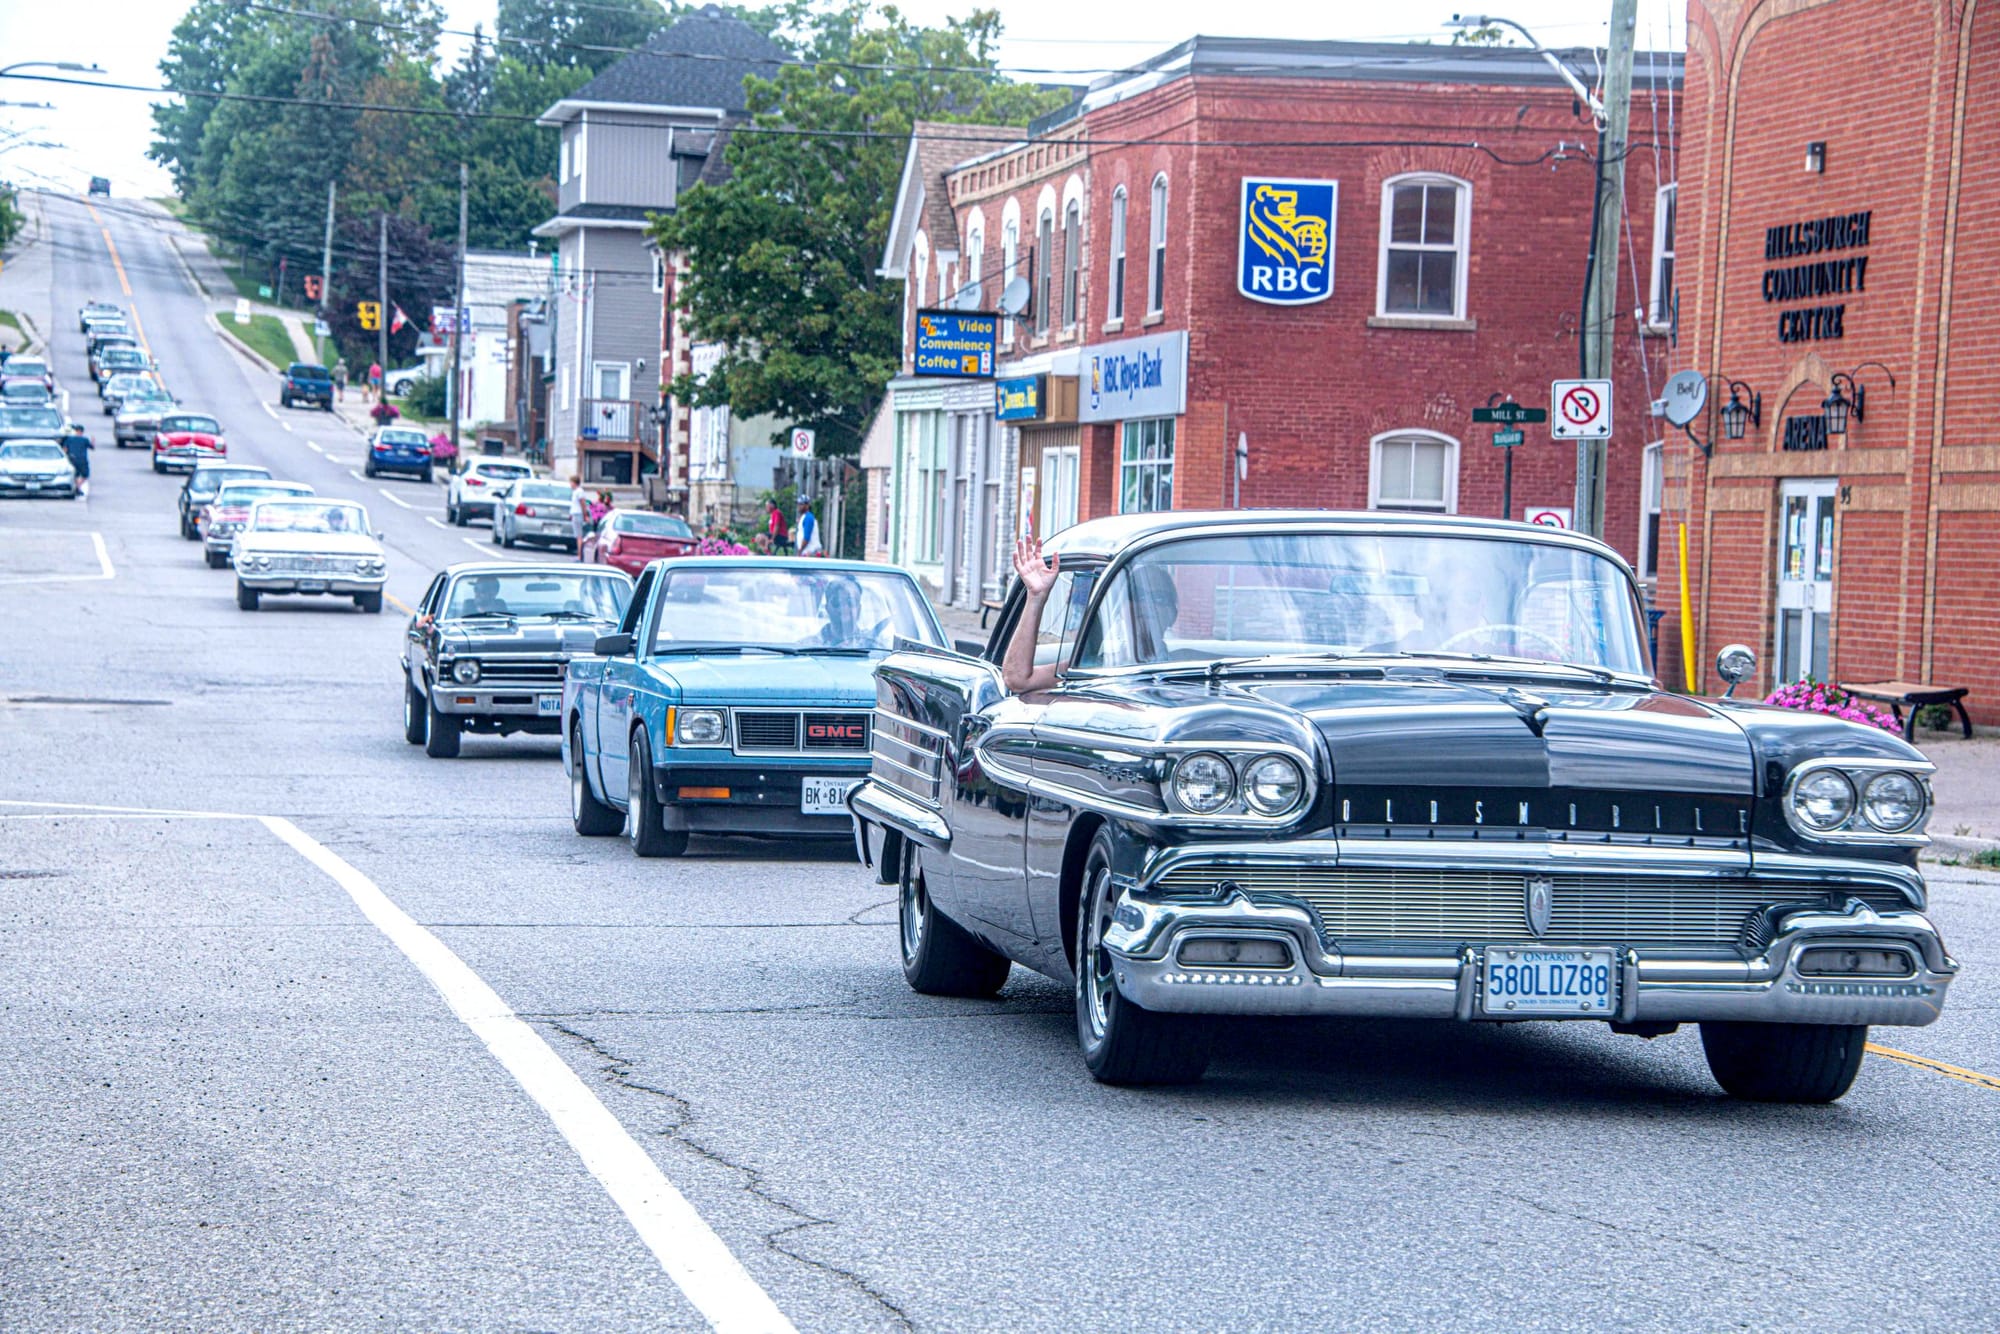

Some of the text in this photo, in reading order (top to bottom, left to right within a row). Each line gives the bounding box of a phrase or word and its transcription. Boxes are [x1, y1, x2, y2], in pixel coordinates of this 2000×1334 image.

[1765, 210, 1872, 261] HILLSBURGH
[1252, 265, 1322, 293] RBC
[1762, 256, 1868, 303] COMMUNITY
[958, 319, 992, 333] Video
[1778, 304, 1845, 342] CENTRE
[919, 336, 991, 351] Convenience
[918, 354, 957, 369] Coffee
[1104, 347, 1163, 400] RBC Royal Bank
[1491, 410, 1512, 420] MILL
[1783, 415, 1828, 451] ARENA
[808, 725, 863, 738] GMC
[1342, 799, 1748, 834] OLDSMOBILE
[1523, 951, 1575, 962] ONTARIO
